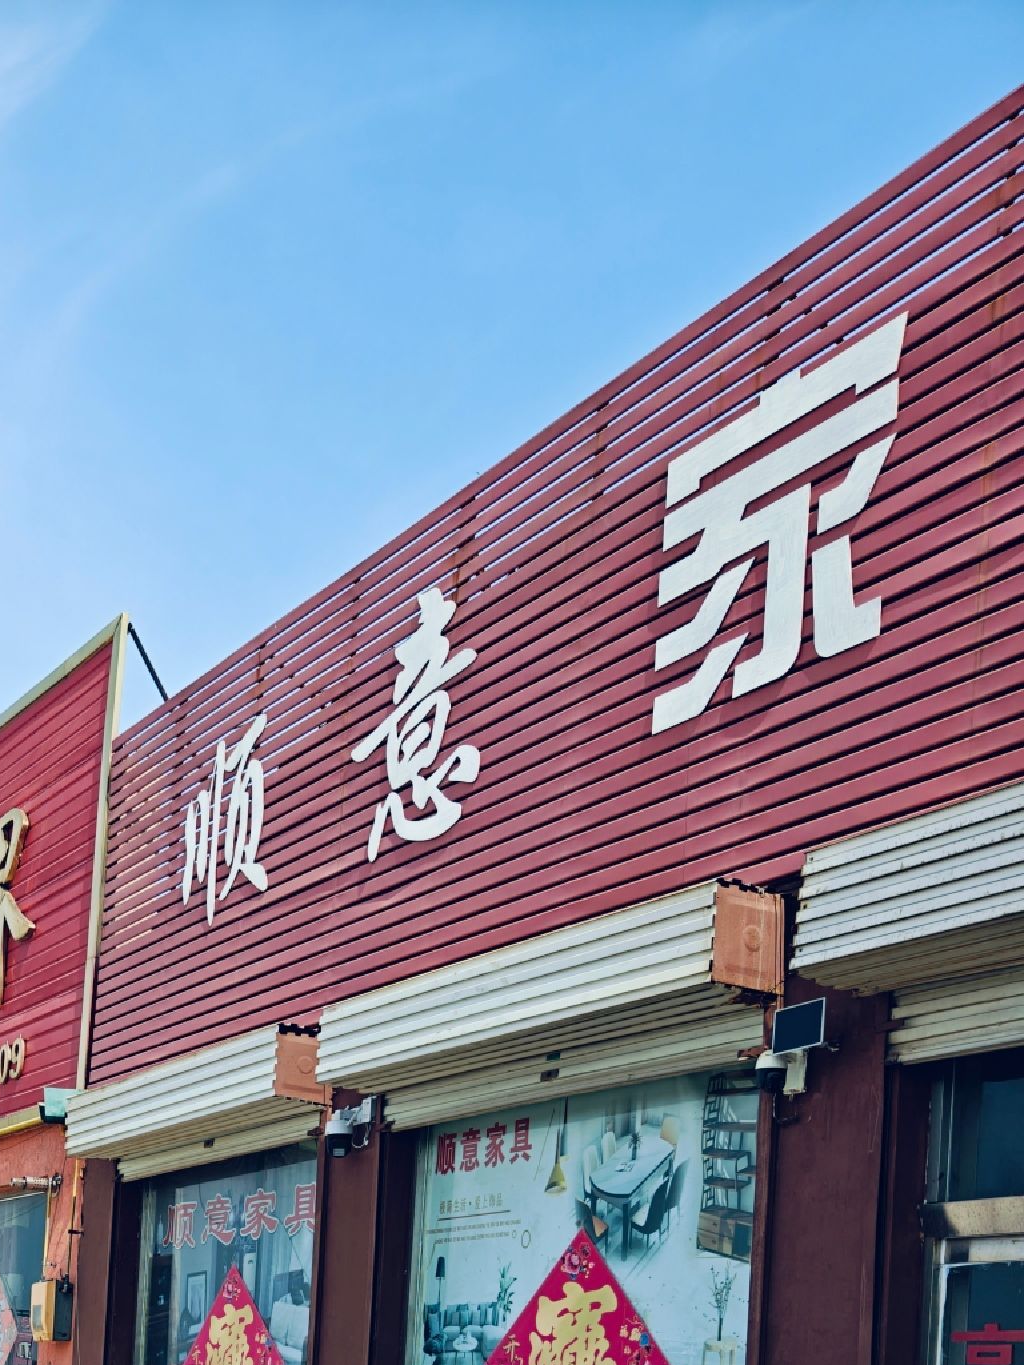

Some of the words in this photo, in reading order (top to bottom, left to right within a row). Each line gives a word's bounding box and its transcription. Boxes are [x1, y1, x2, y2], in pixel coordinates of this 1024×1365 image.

[435, 1117, 533, 1177] 顺意家具
[163, 1182, 316, 1250] 顺意家具
